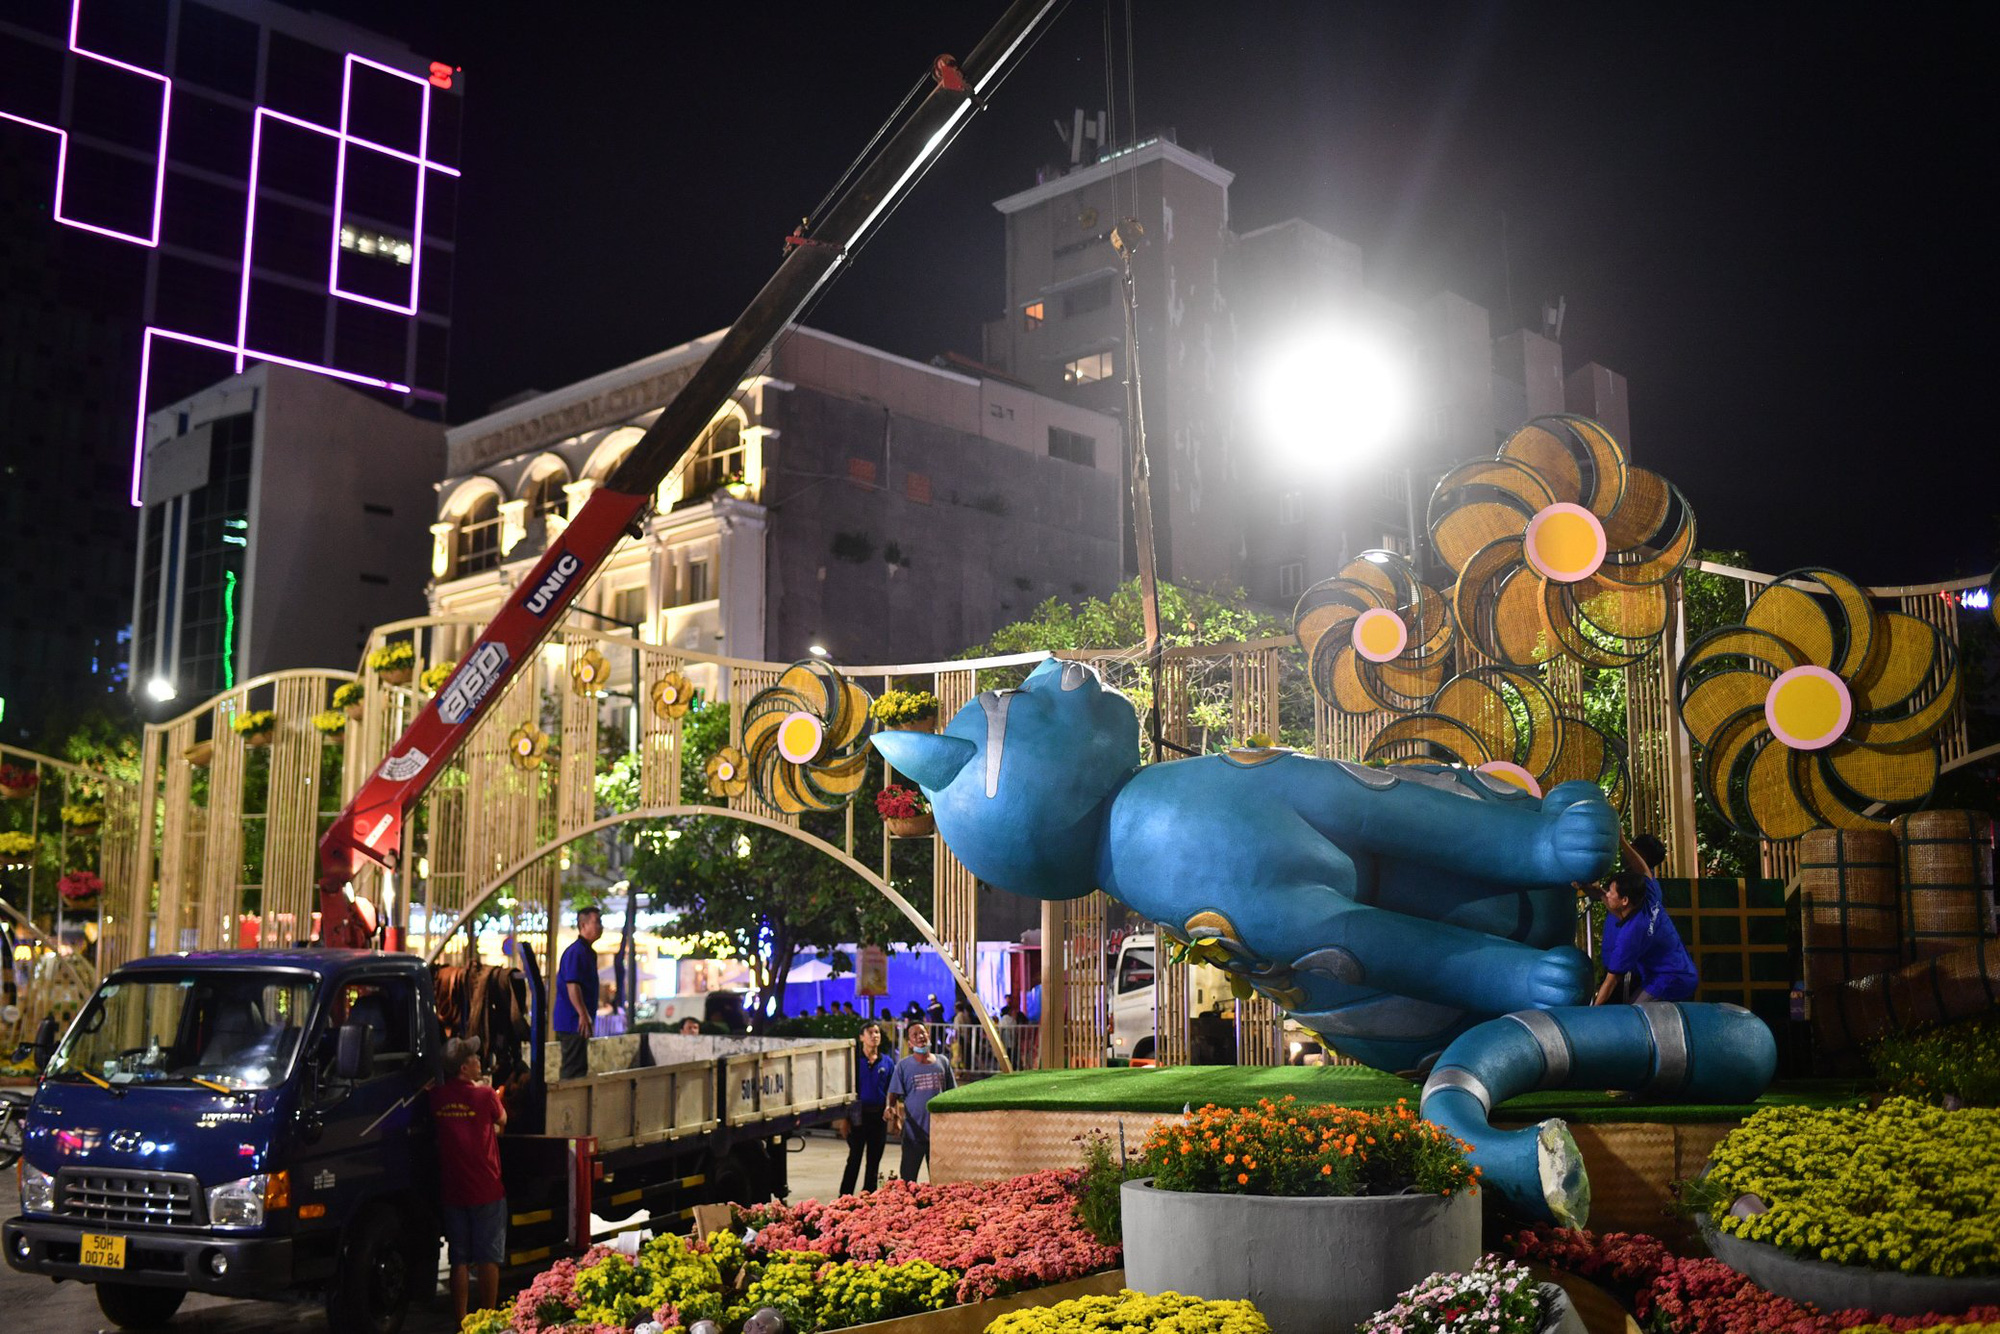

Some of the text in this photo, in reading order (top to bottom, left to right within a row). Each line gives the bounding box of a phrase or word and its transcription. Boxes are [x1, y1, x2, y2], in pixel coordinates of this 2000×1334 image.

[526, 554, 578, 614] UNIC
[444, 645, 503, 721] 360
[85, 1250, 120, 1266] 007.84
[93, 1235, 114, 1250] 50H
